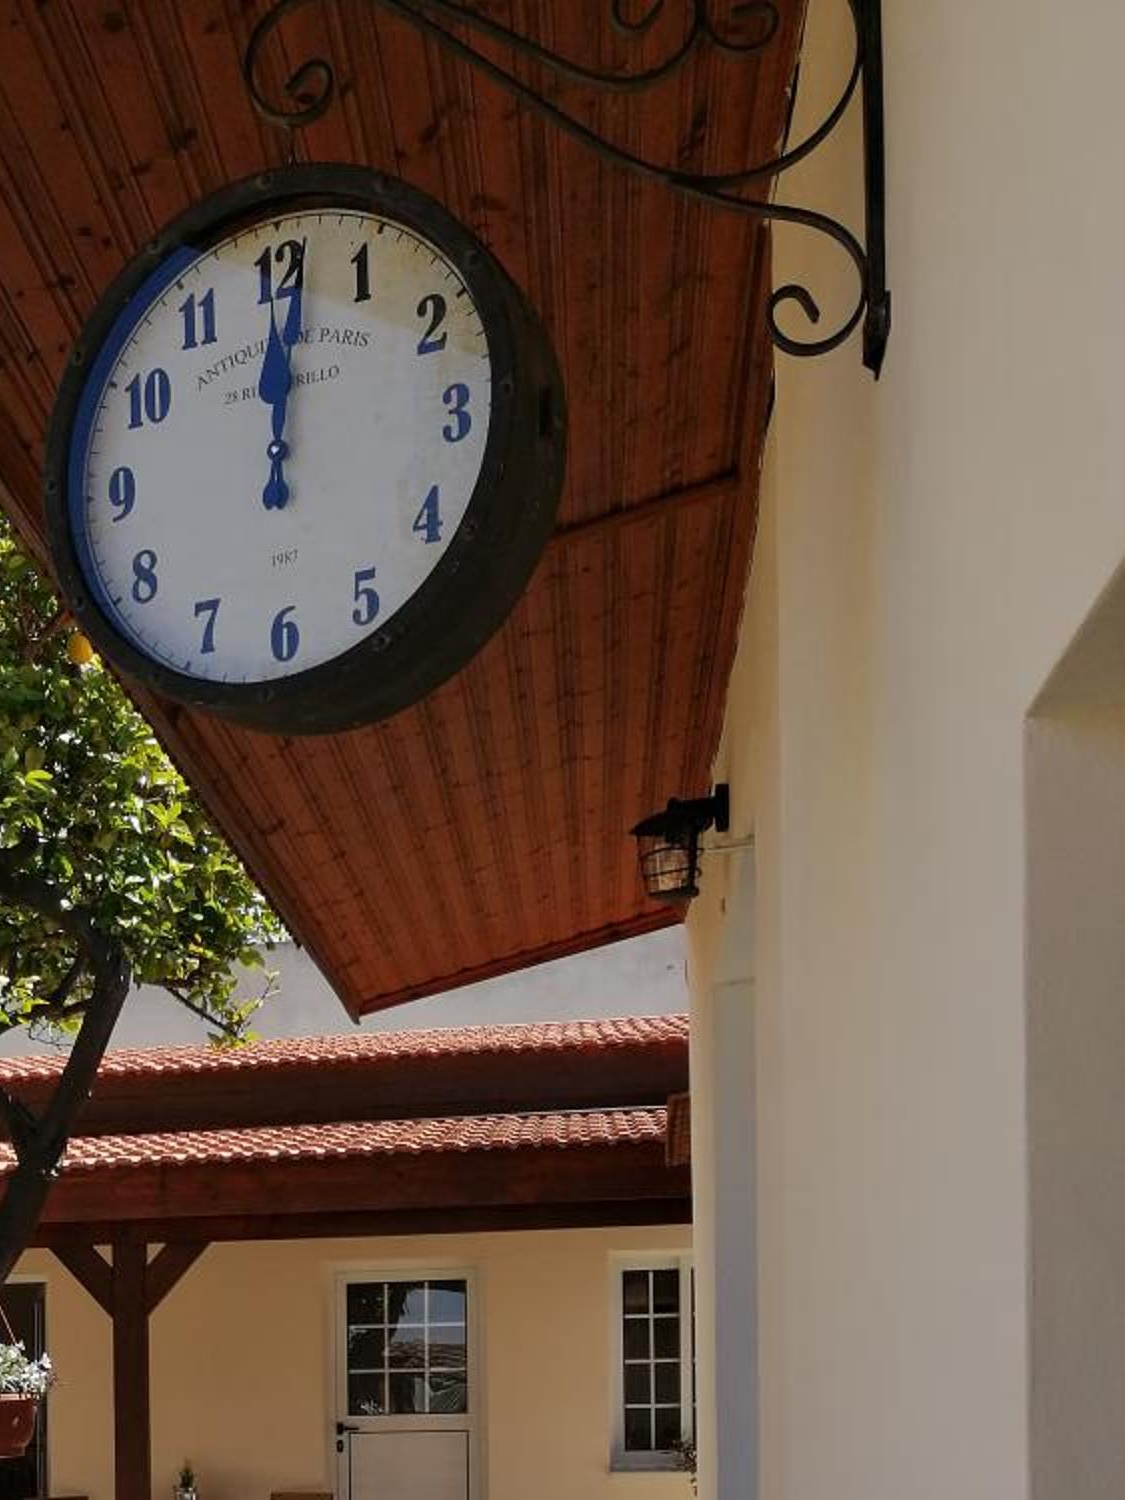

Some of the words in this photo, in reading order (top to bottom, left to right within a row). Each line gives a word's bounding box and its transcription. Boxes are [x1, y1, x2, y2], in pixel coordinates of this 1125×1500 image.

[254, 239, 303, 305] 12
[350, 242, 372, 303] 1
[178, 288, 218, 351] 11
[318, 326, 372, 348] PARIS
[416, 293, 448, 356] 2
[124, 367, 172, 430] 10
[442, 383, 472, 443] 3
[108, 466, 136, 523] 9
[412, 484, 444, 545] 4
[131, 549, 158, 605] 8
[352, 566, 380, 627] 5
[194, 598, 222, 655] 7
[270, 605, 300, 663] 6
